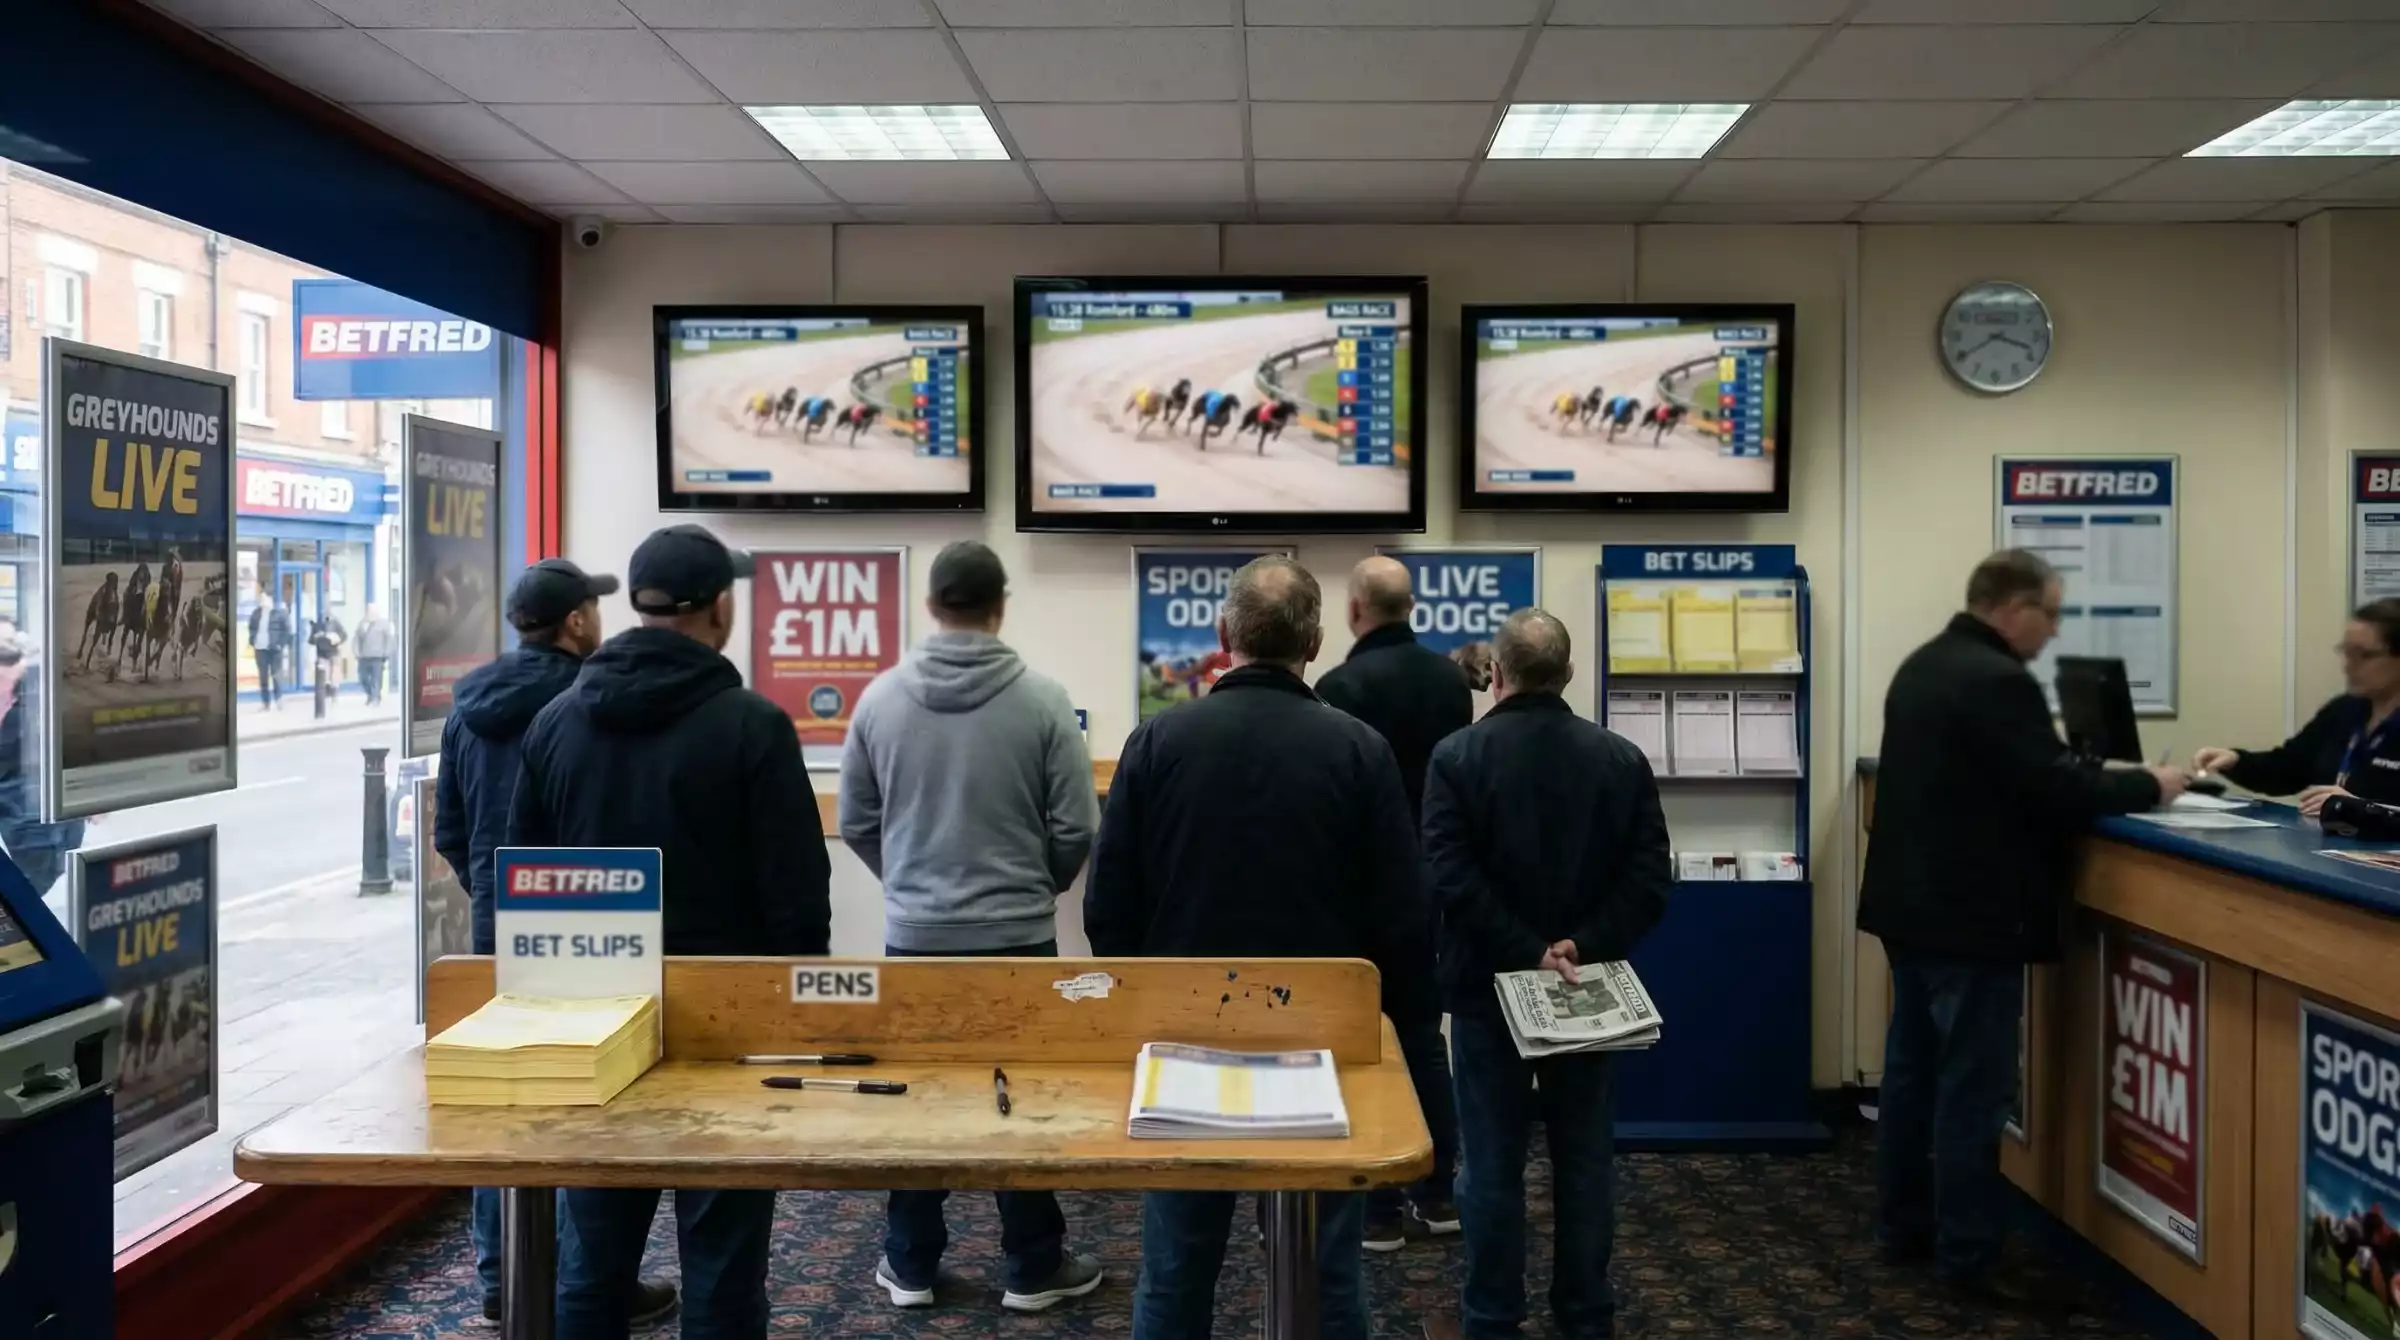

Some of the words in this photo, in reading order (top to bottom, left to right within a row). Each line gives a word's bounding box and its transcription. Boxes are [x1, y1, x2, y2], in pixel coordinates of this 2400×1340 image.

[310, 320, 491, 353] BETFRED
[67, 393, 219, 446] GREYHOUNDS
[91, 438, 202, 514] LIVE
[2016, 471, 2159, 497] BETFRED
[427, 483, 485, 539] LIVE
[772, 561, 878, 604] WIN
[1419, 565, 1501, 598] LIVE
[1645, 551, 1688, 572] BET
[1692, 551, 1755, 572] SLIPS
[769, 608, 881, 657] £1M
[513, 868, 646, 893] BETFRED
[88, 877, 204, 931] GREYHOUNDS
[117, 912, 180, 967] LIVE
[513, 933, 564, 958] BET
[571, 933, 645, 958] SLIPS
[797, 971, 874, 997] PENS
[2113, 973, 2191, 1068] WIN
[2111, 1043, 2190, 1144] £1M
